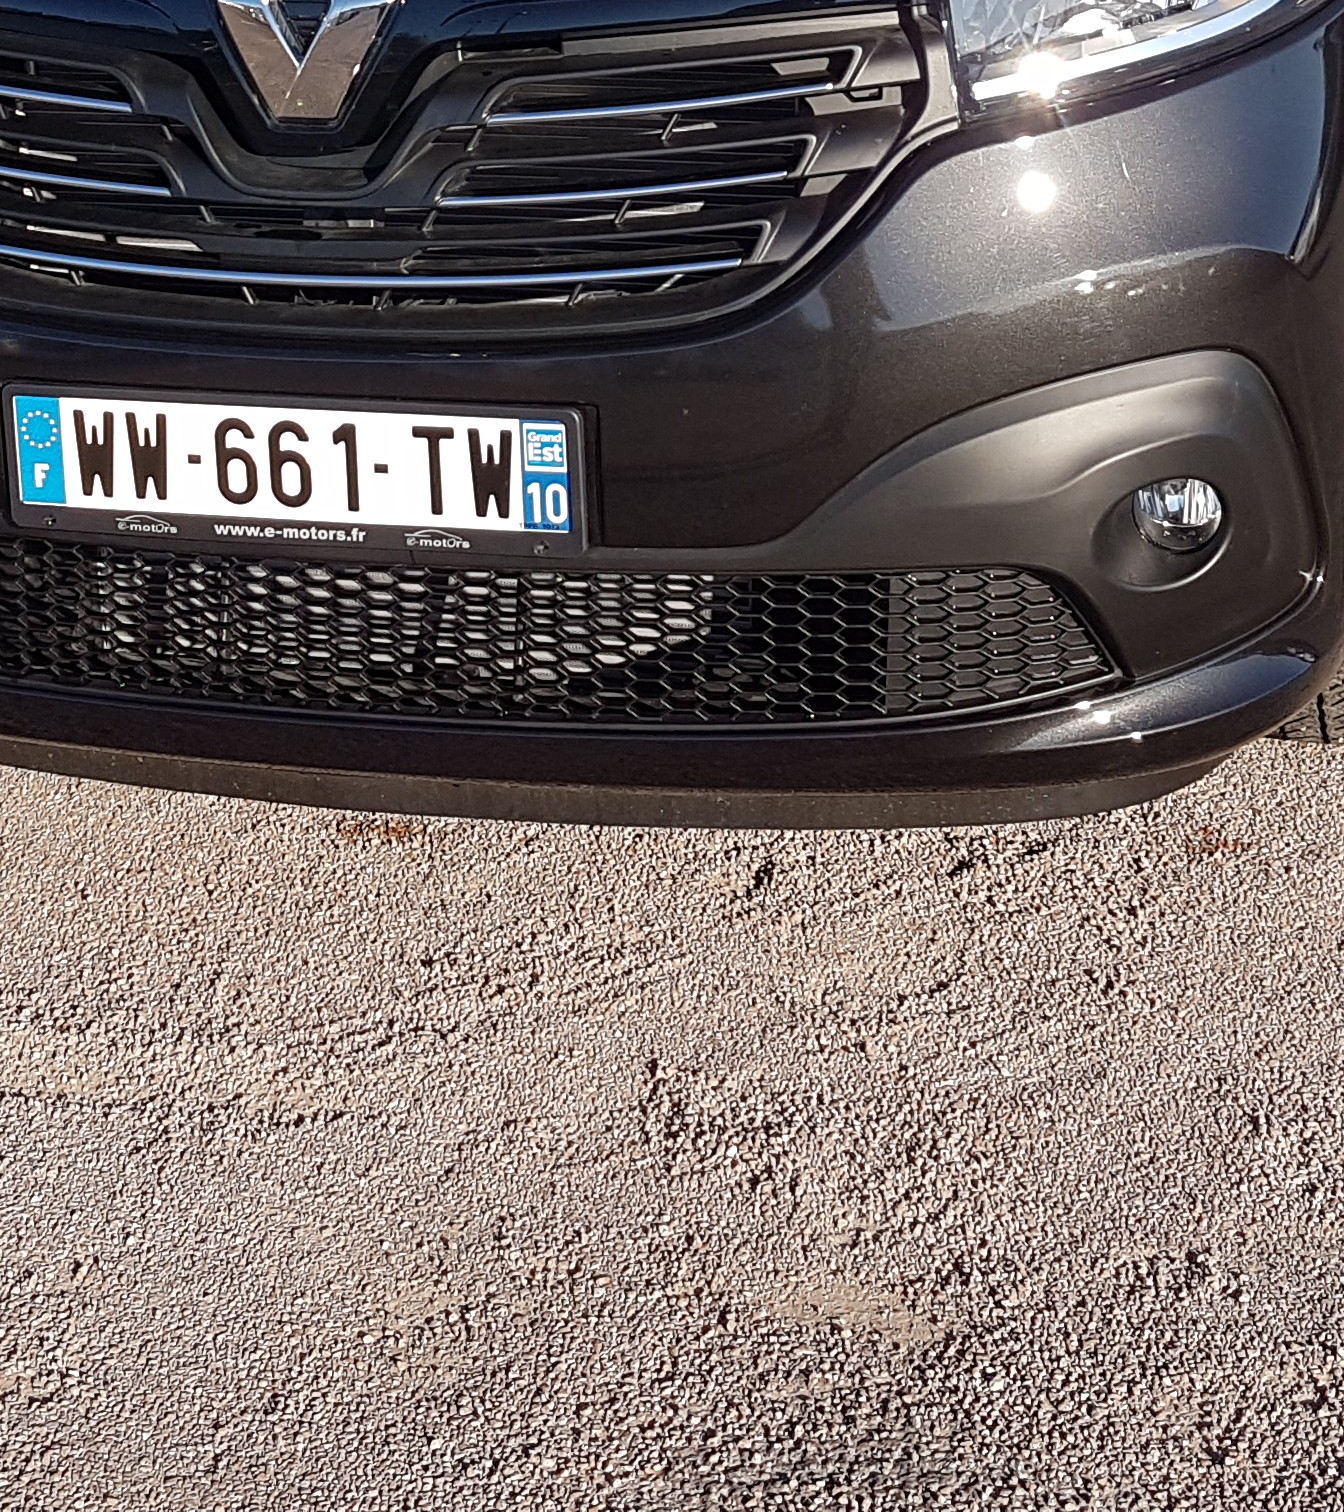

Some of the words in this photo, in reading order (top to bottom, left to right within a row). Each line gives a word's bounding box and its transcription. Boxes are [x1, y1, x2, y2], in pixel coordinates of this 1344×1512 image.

[527, 431, 562, 444] Grand
[527, 442, 564, 463] Est
[33, 462, 51, 489] F
[526, 481, 568, 525] 10
[213, 523, 367, 543] www.e-motors.fr
